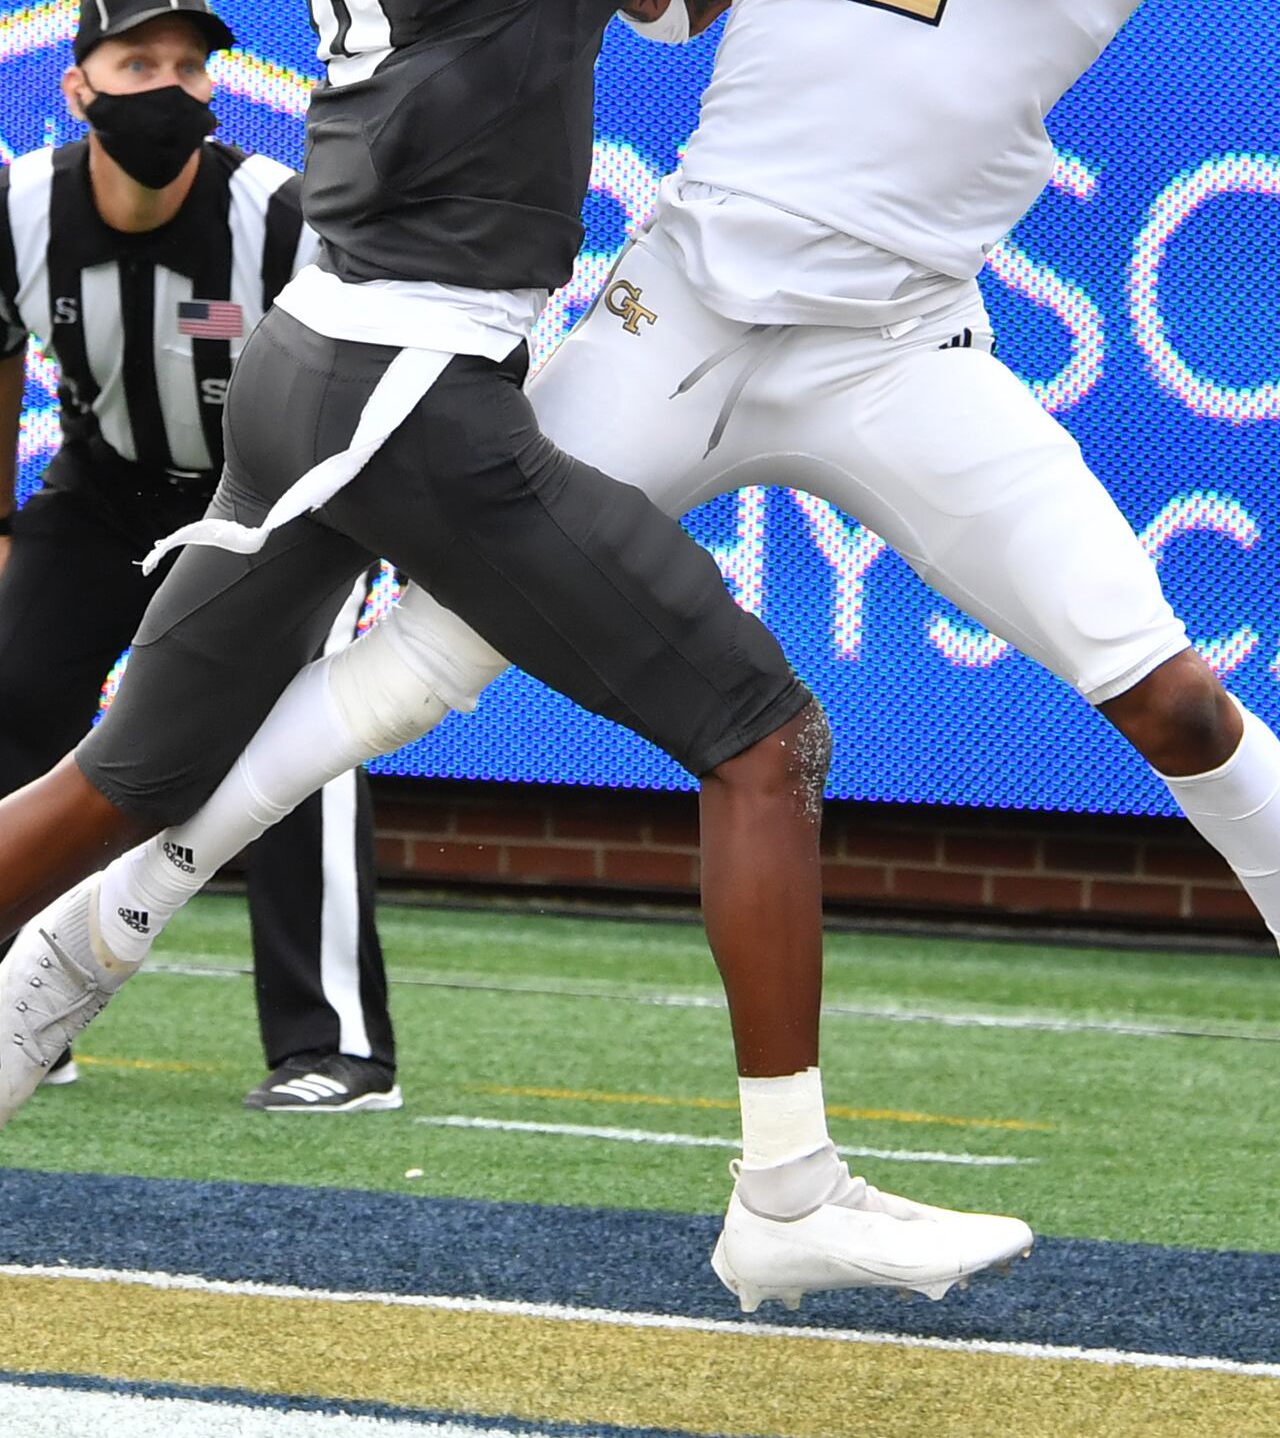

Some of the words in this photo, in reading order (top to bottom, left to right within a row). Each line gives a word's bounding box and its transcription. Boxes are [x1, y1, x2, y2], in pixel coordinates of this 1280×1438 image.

[54, 297, 77, 324] S
[604, 279, 658, 335] GT
[163, 841, 197, 874] adidas
